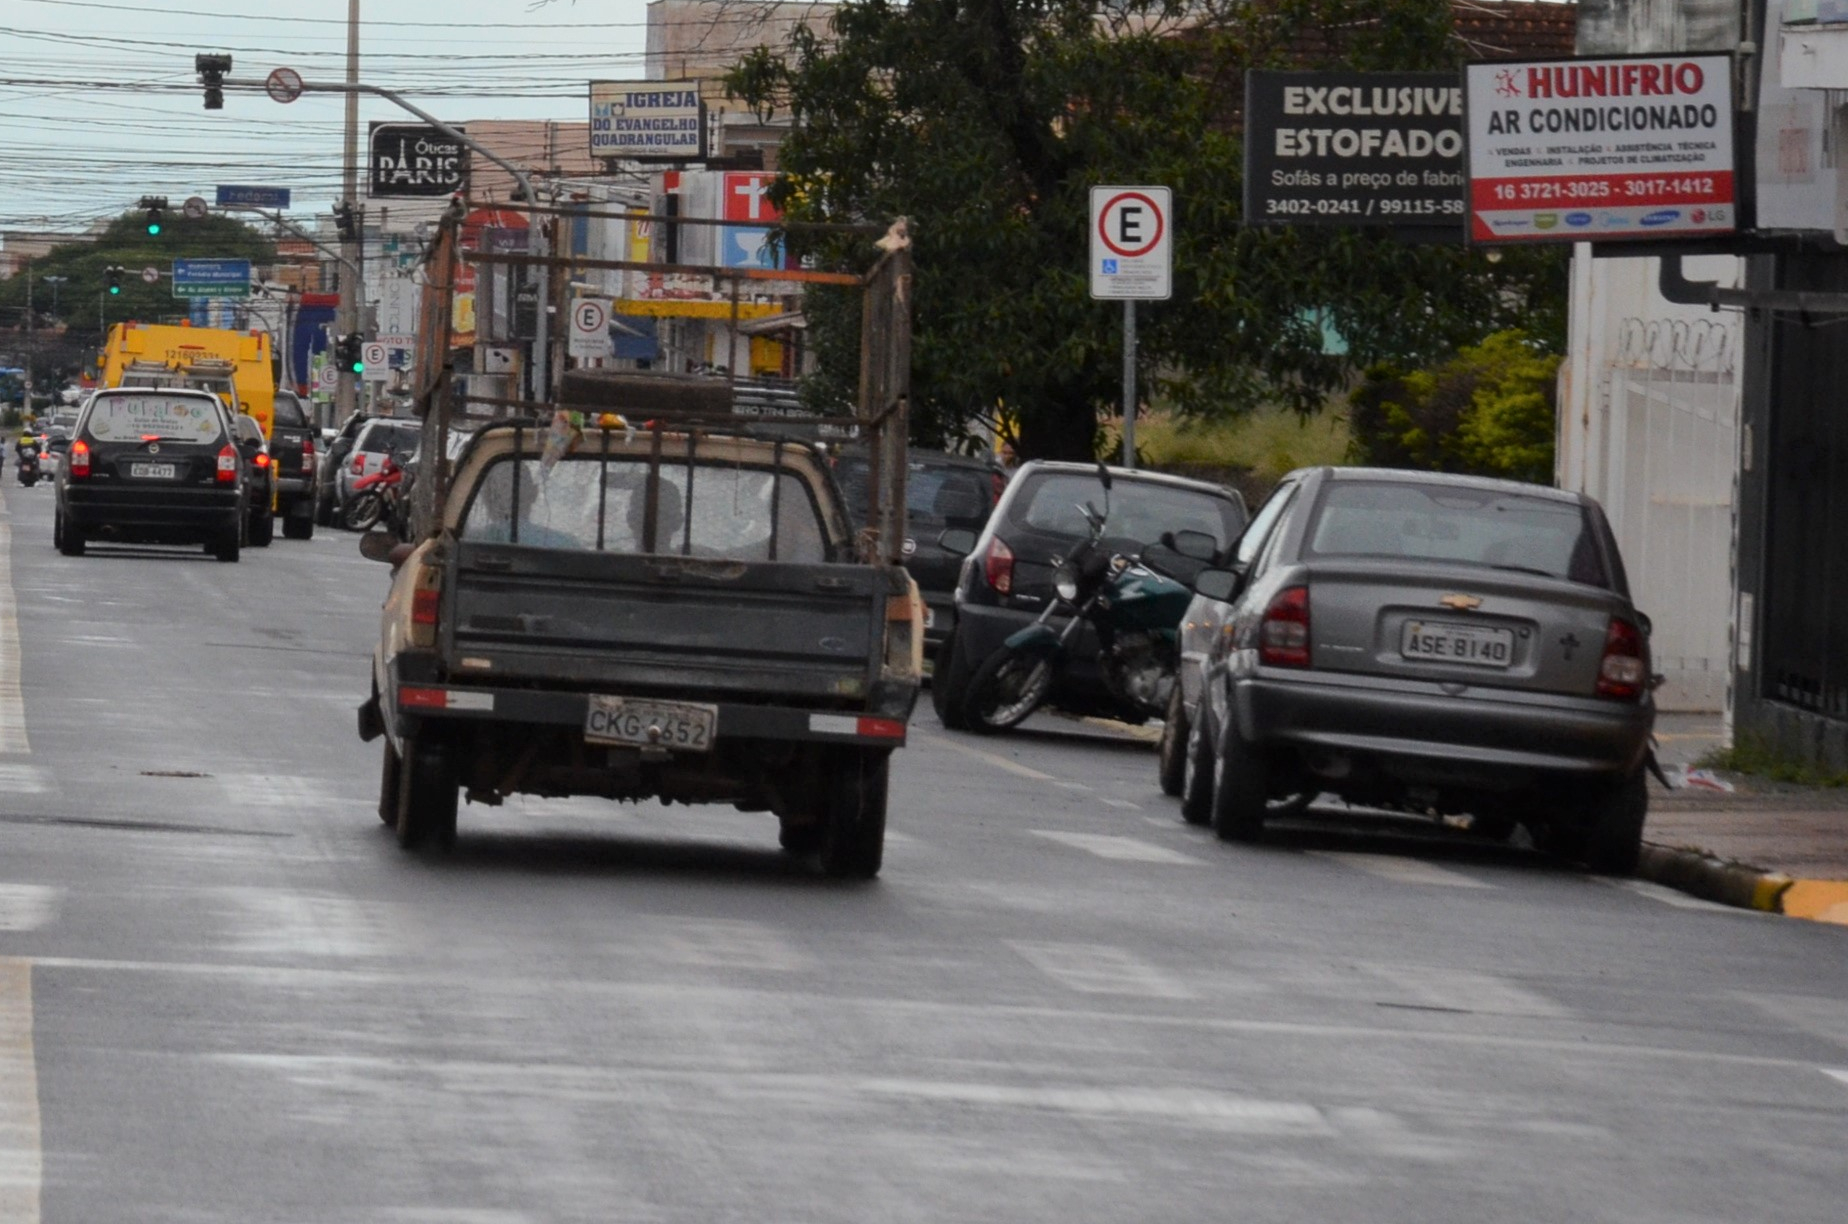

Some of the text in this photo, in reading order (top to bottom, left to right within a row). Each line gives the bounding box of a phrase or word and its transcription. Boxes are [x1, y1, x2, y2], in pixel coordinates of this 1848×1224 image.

[1527, 62, 1704, 99] HUNIFRIO
[625, 91, 698, 108] IGREJA
[1283, 86, 1463, 115] EXCLUSIVE
[593, 118, 697, 131] DO EVANGELHO
[1488, 104, 1718, 135] AR CONDICIONADO
[414, 137, 459, 155] Óticas
[592, 133, 698, 146] QUADRANGULAR
[1275, 128, 1463, 158] ESTOFADO
[1495, 141, 1716, 156] VENDAS INSTALAÇÃO ASSISTÊNCIA TÉCNICA
[379, 139, 460, 184] PARIS
[1504, 152, 1706, 167] ENGENHARIA PROJETOS DE CLIMATIZAÇÃO
[1271, 169, 1322, 186] Sofás
[1326, 173, 1338, 186] a
[1342, 172, 1391, 189] preço
[1395, 169, 1417, 186] de
[1494, 184, 1516, 200] 16
[1520, 181, 1610, 198] 3721-3025
[1624, 178, 1714, 195] 3017-1412
[1266, 199, 1361, 214] 3402-0241
[1708, 209, 1726, 221] LG
[1120, 206, 1142, 243] E
[583, 309, 594, 326] E
[372, 348, 379, 360] E
[1409, 634, 1506, 661] ASE-8140
